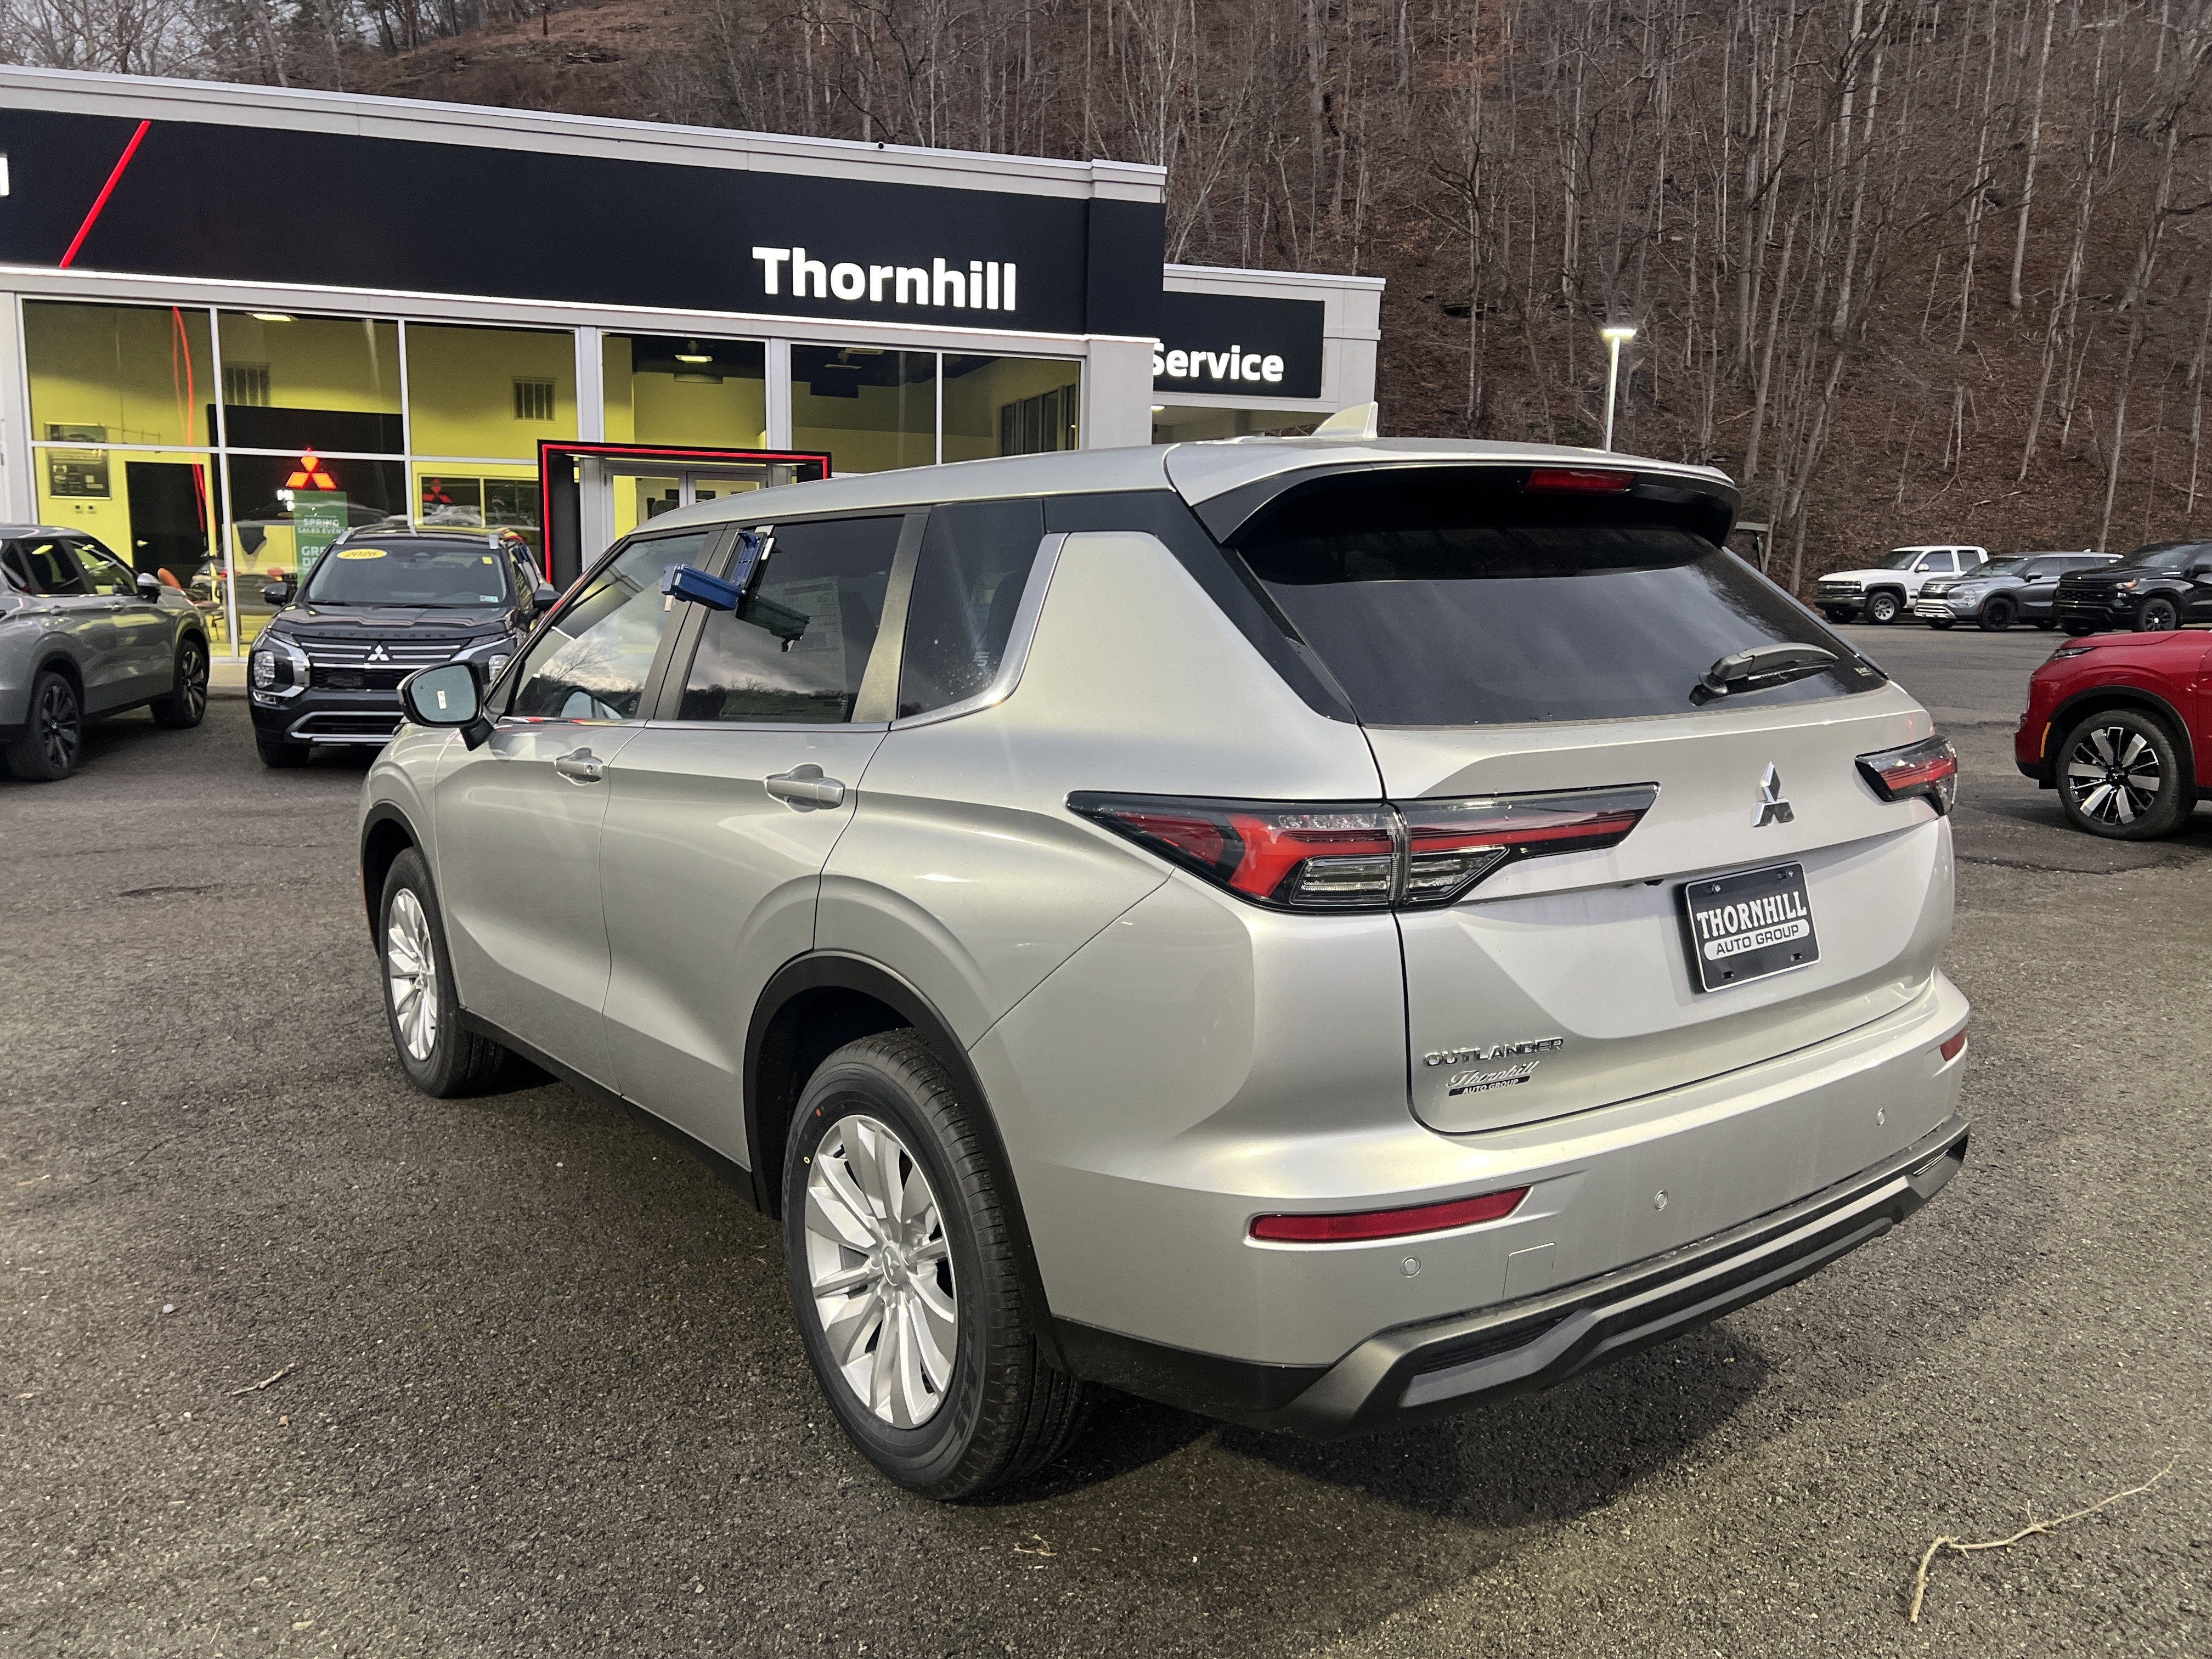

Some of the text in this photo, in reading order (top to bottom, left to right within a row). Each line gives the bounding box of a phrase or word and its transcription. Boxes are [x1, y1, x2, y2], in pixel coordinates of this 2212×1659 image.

[752, 246, 1016, 311] Thornhill
[1153, 342, 1284, 382] Service
[303, 518, 340, 527] SPRING
[1696, 891, 1807, 939] THORNHILL
[1716, 924, 1799, 956] AUTO GROUP
[1423, 1036, 1564, 1066] OUTLANDER
[1445, 1060, 1541, 1088] Thornhill
[1462, 1079, 1519, 1094] AUTO GROUP
